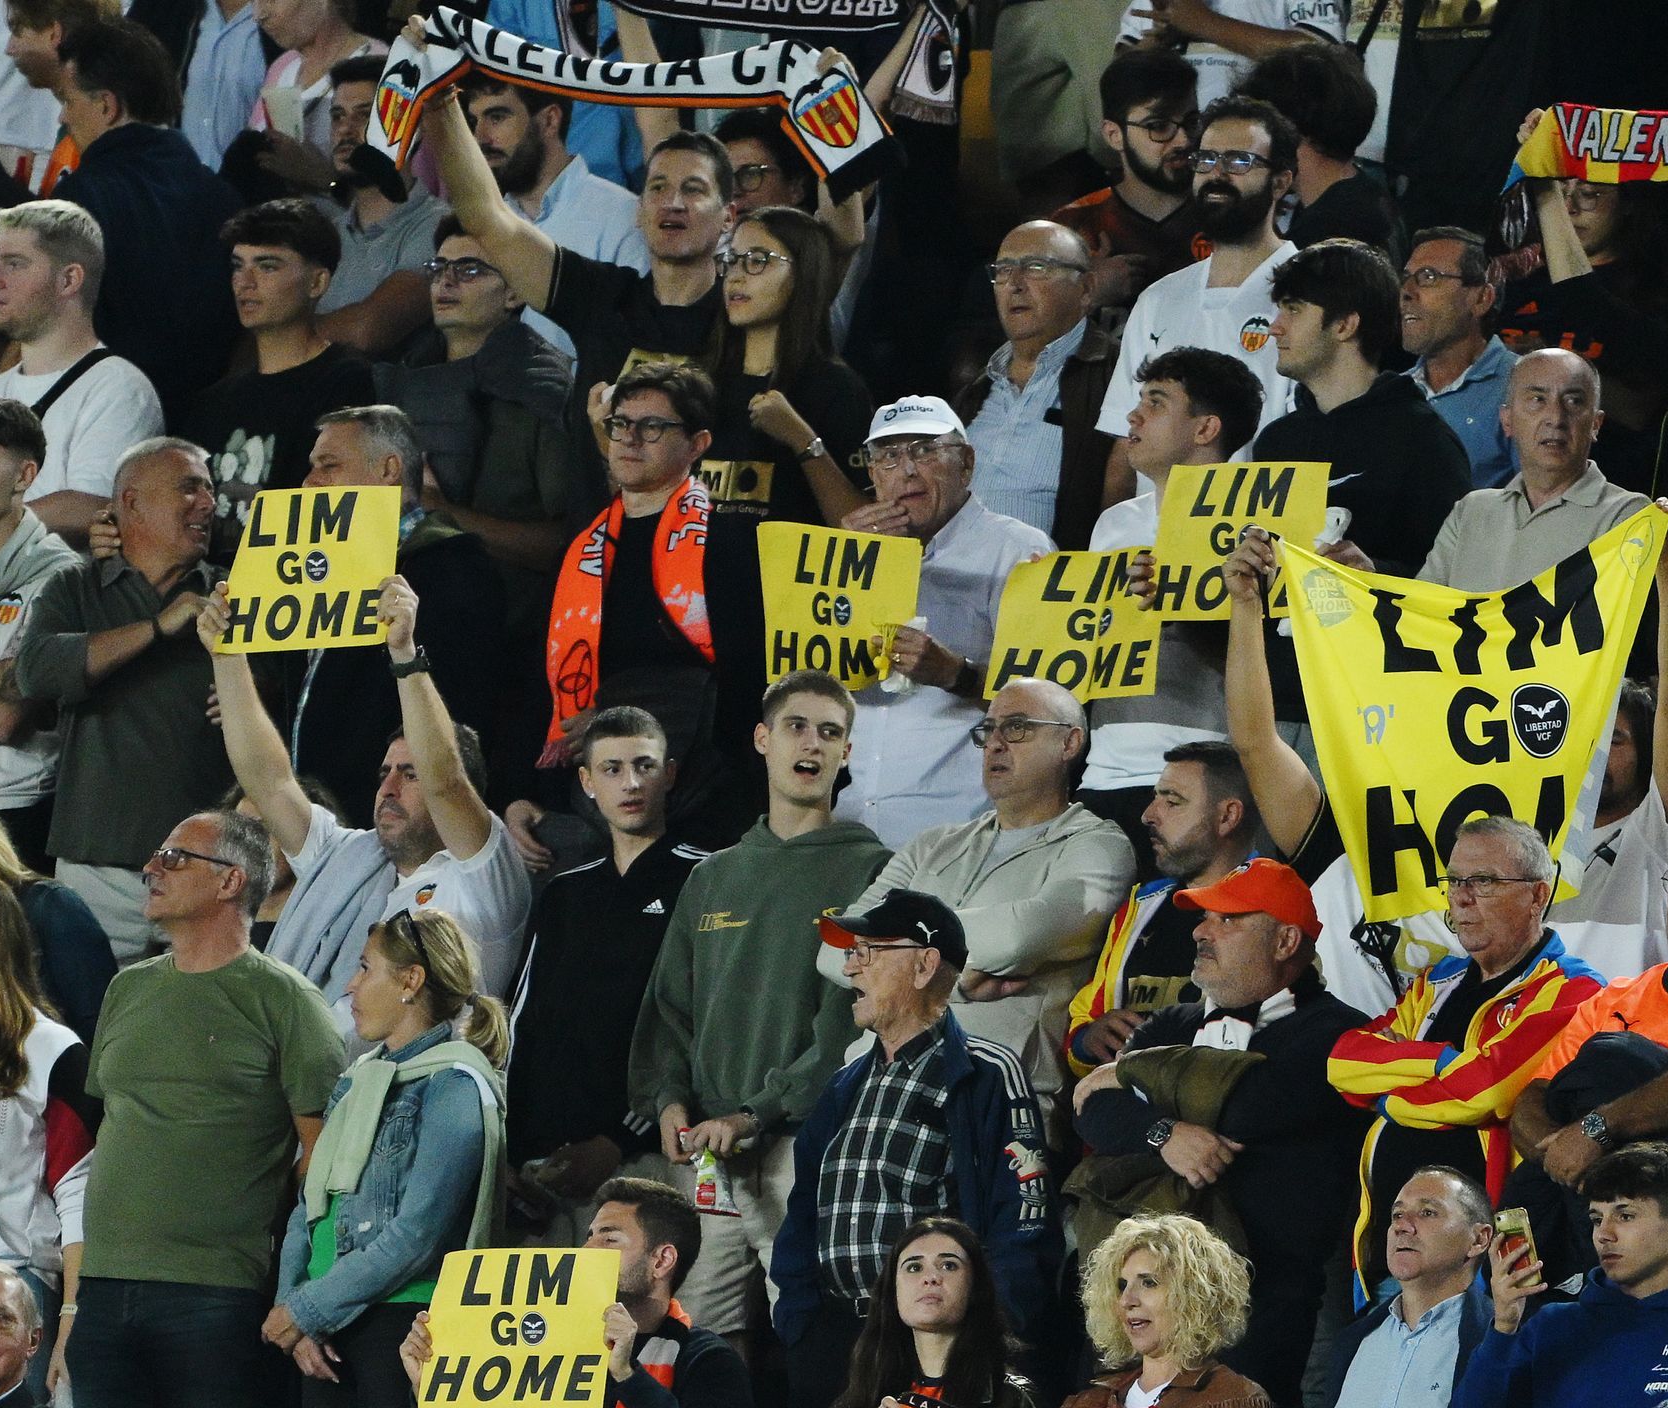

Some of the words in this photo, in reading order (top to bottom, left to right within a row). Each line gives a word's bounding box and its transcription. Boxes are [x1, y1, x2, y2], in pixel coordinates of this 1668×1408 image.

[430, 16, 705, 90] VALENCIA
[1188, 467, 1296, 517] LIM
[248, 491, 358, 548] LIM
[795, 532, 881, 590] LIM
[1041, 550, 1136, 603] LIM
[221, 589, 380, 645] HOME
[1369, 542, 1607, 677] LIM
[771, 629, 875, 679] HOM
[992, 640, 1152, 695] HOME
[1524, 720, 1562, 733] LIBERTAD
[1536, 731, 1552, 742] VCF
[1365, 773, 1560, 894] HO
[460, 1253, 577, 1306] LIM
[423, 1353, 602, 1403] HOME
